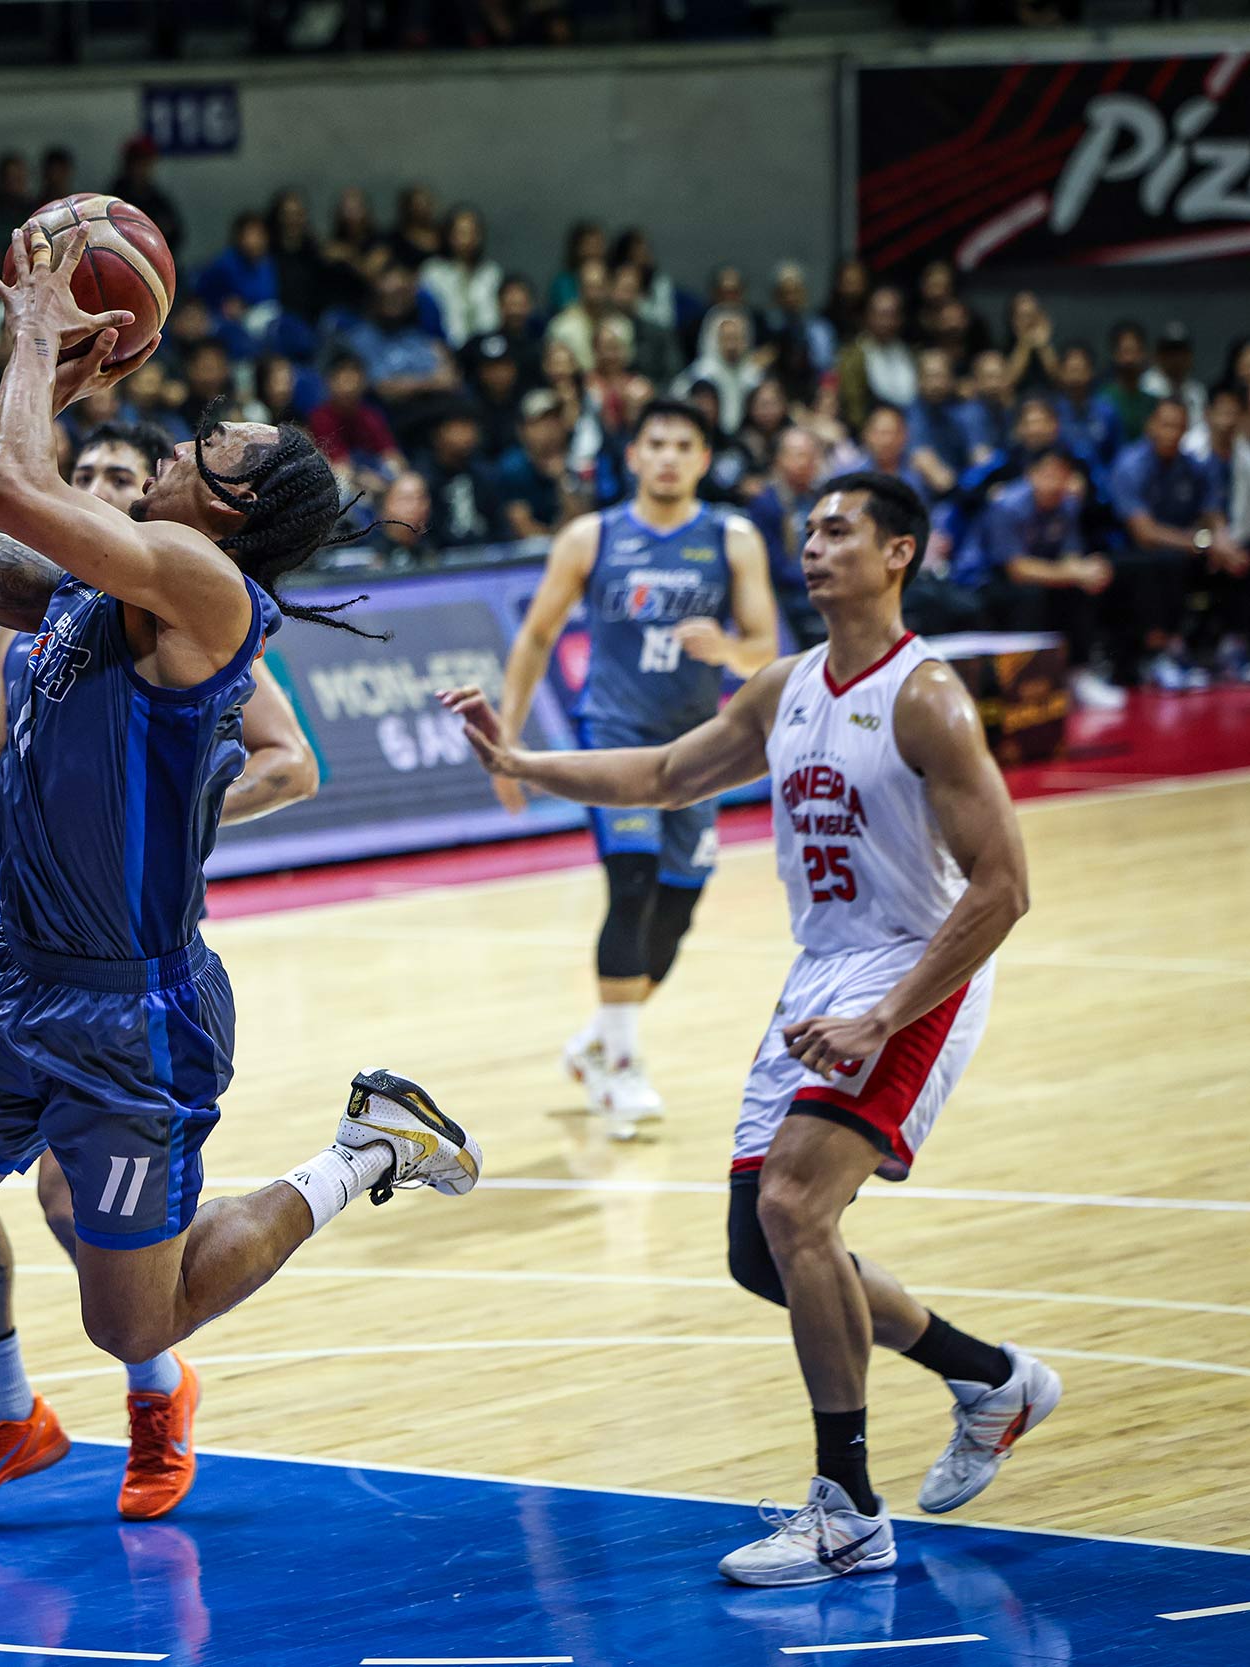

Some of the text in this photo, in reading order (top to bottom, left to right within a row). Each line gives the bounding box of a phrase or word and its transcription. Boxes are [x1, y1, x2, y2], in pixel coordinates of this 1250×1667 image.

[151, 98, 237, 144] 116
[803, 845, 858, 904] 25
[97, 1155, 151, 1217] 11
